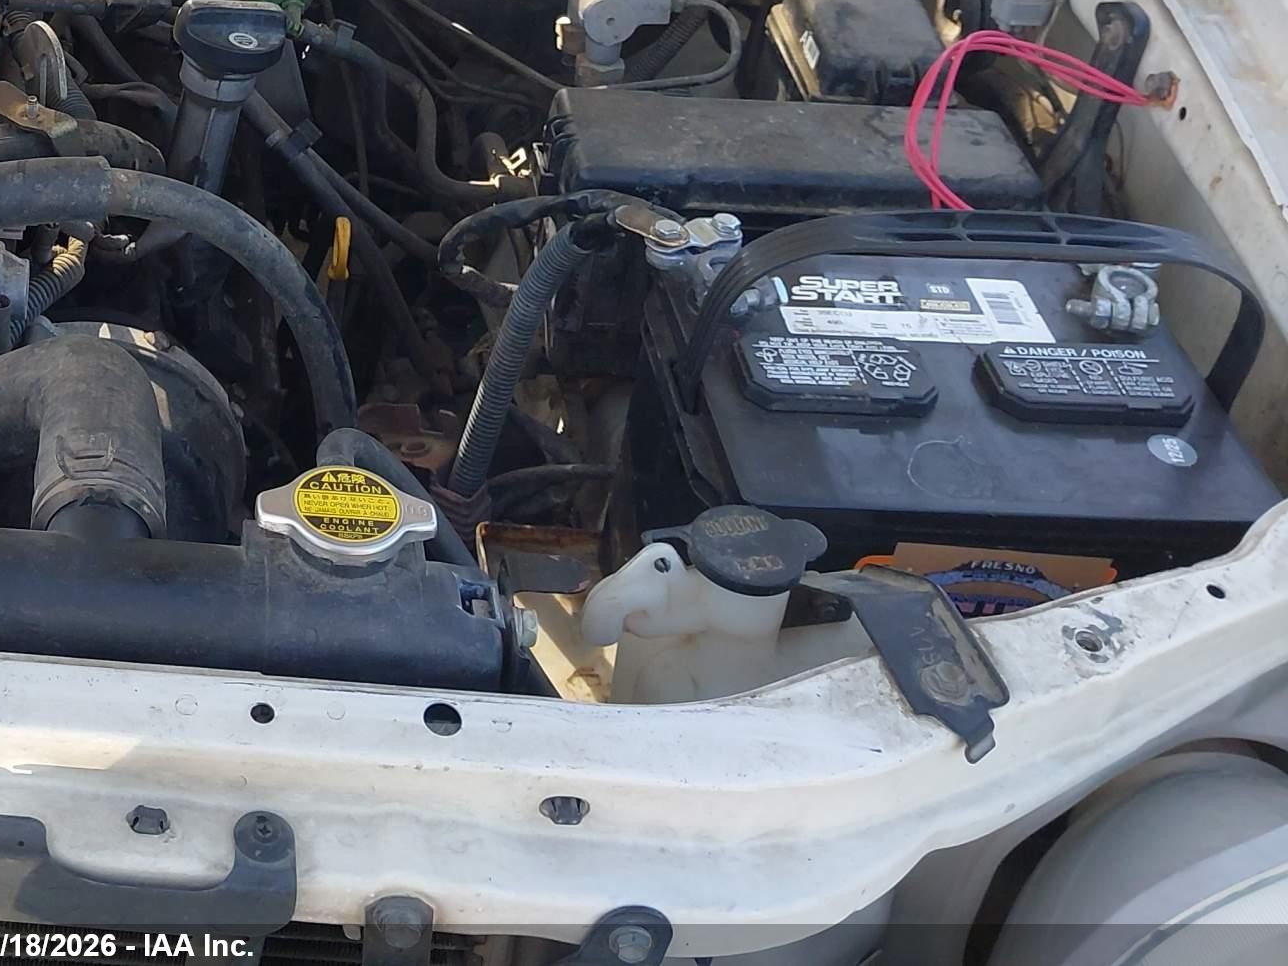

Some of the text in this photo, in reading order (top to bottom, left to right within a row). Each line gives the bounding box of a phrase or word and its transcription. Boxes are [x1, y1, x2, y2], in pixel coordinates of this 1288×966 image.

[799, 276, 899, 292] SUPER
[791, 286, 902, 305] START
[1016, 346, 1077, 357] DANGER
[1093, 349, 1147, 359] POISON
[309, 481, 382, 494] CAUTION
[323, 517, 374, 526] ENGINE
[319, 523, 380, 534] COOLANT
[970, 559, 1037, 575] FRESNO
